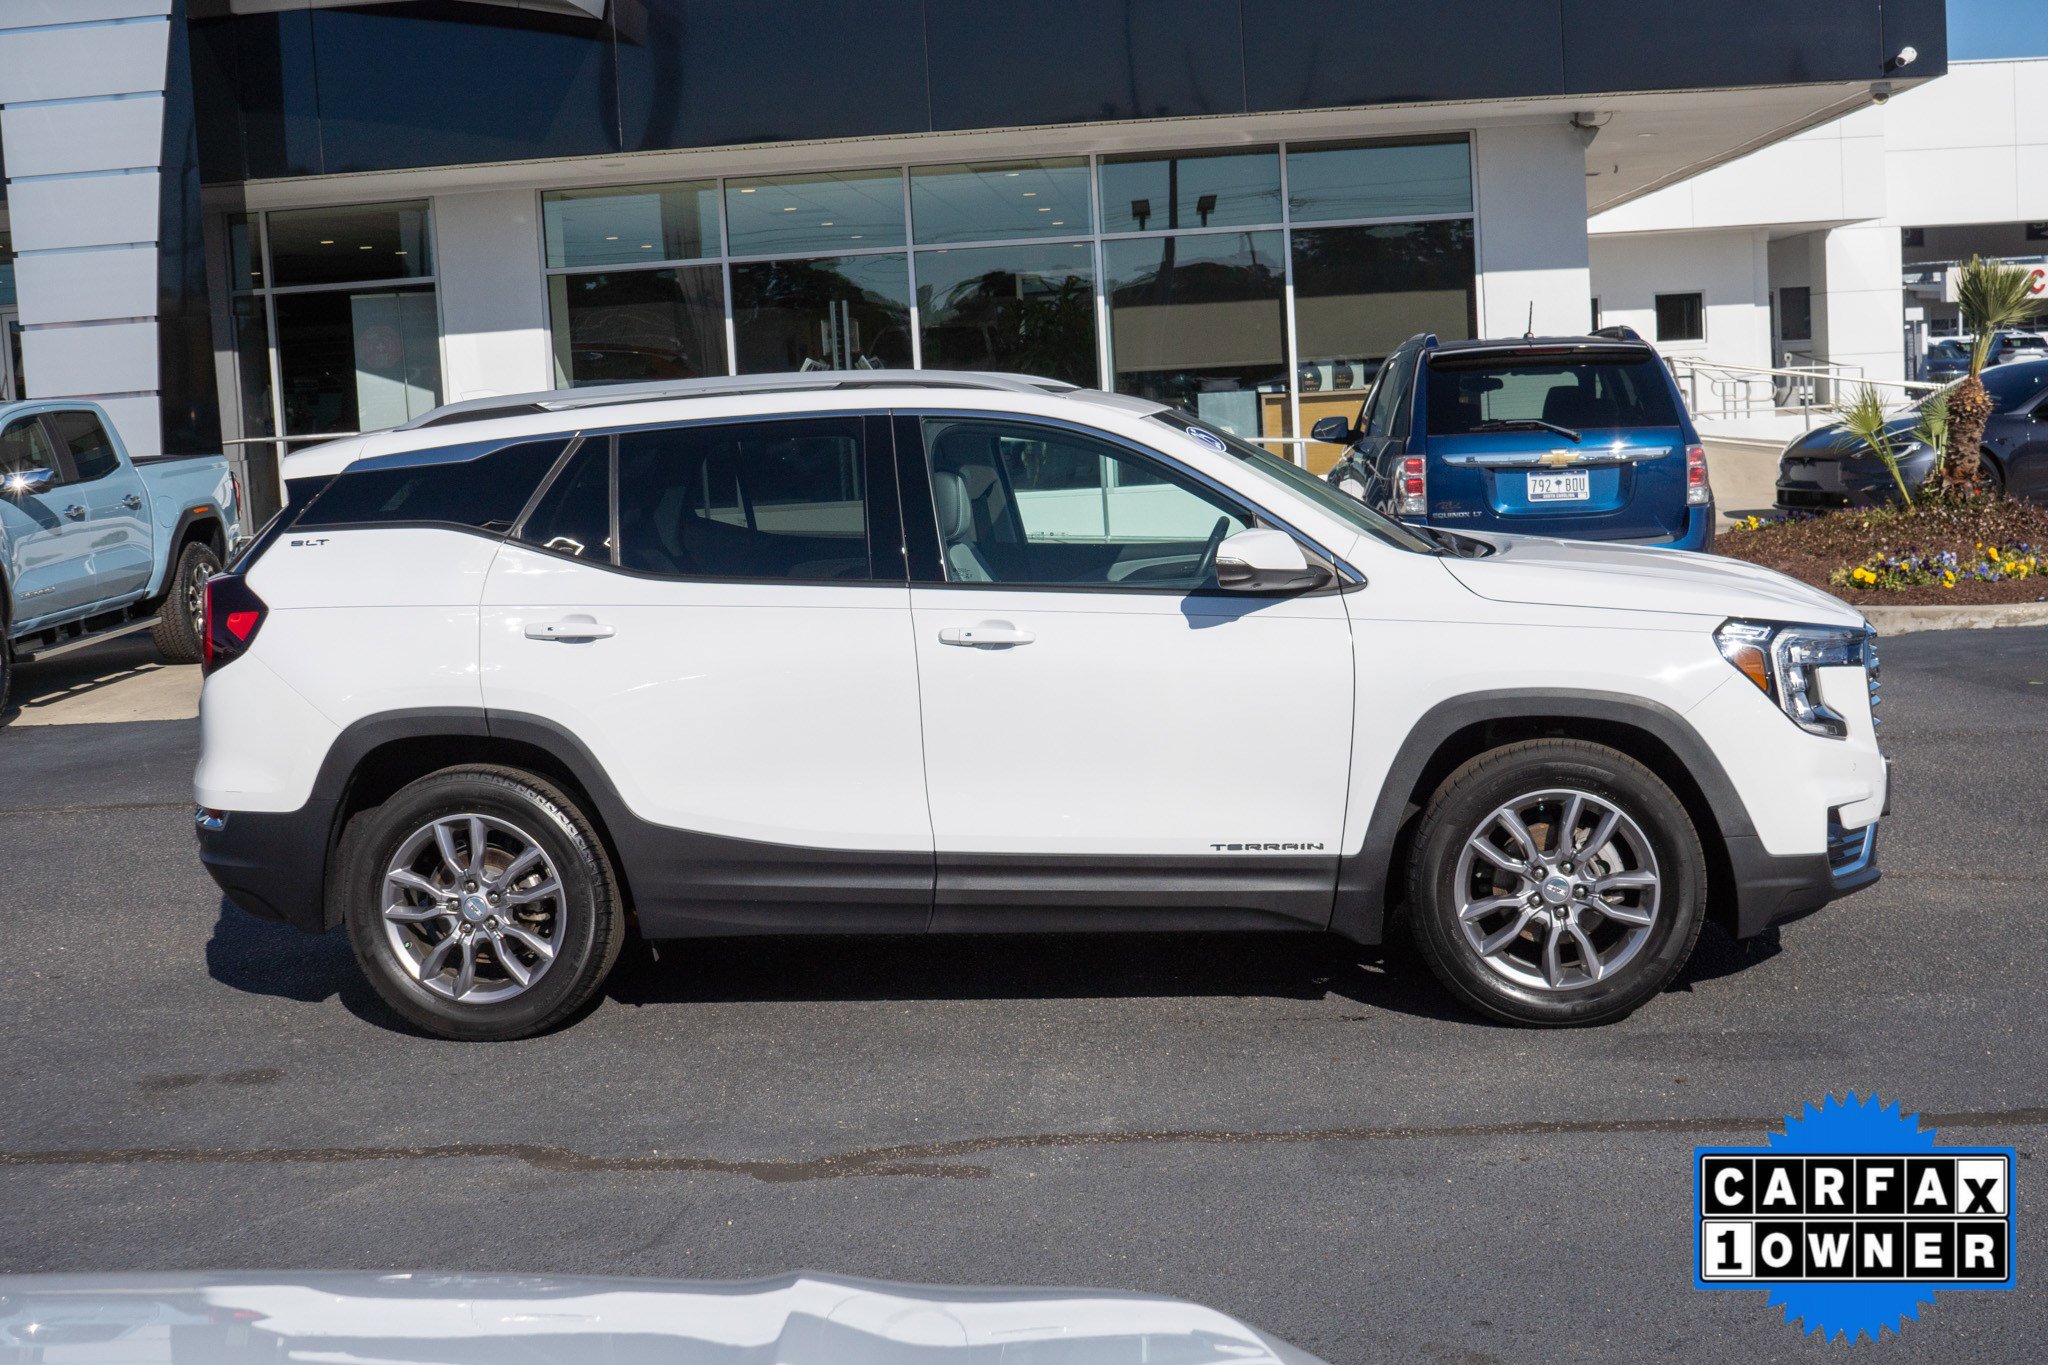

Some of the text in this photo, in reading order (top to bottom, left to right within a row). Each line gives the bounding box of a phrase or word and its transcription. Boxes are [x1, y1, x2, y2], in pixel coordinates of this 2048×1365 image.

[1532, 479, 1551, 492] 792
[290, 539, 330, 547] SLT
[1209, 843, 1324, 851] TERRAIN
